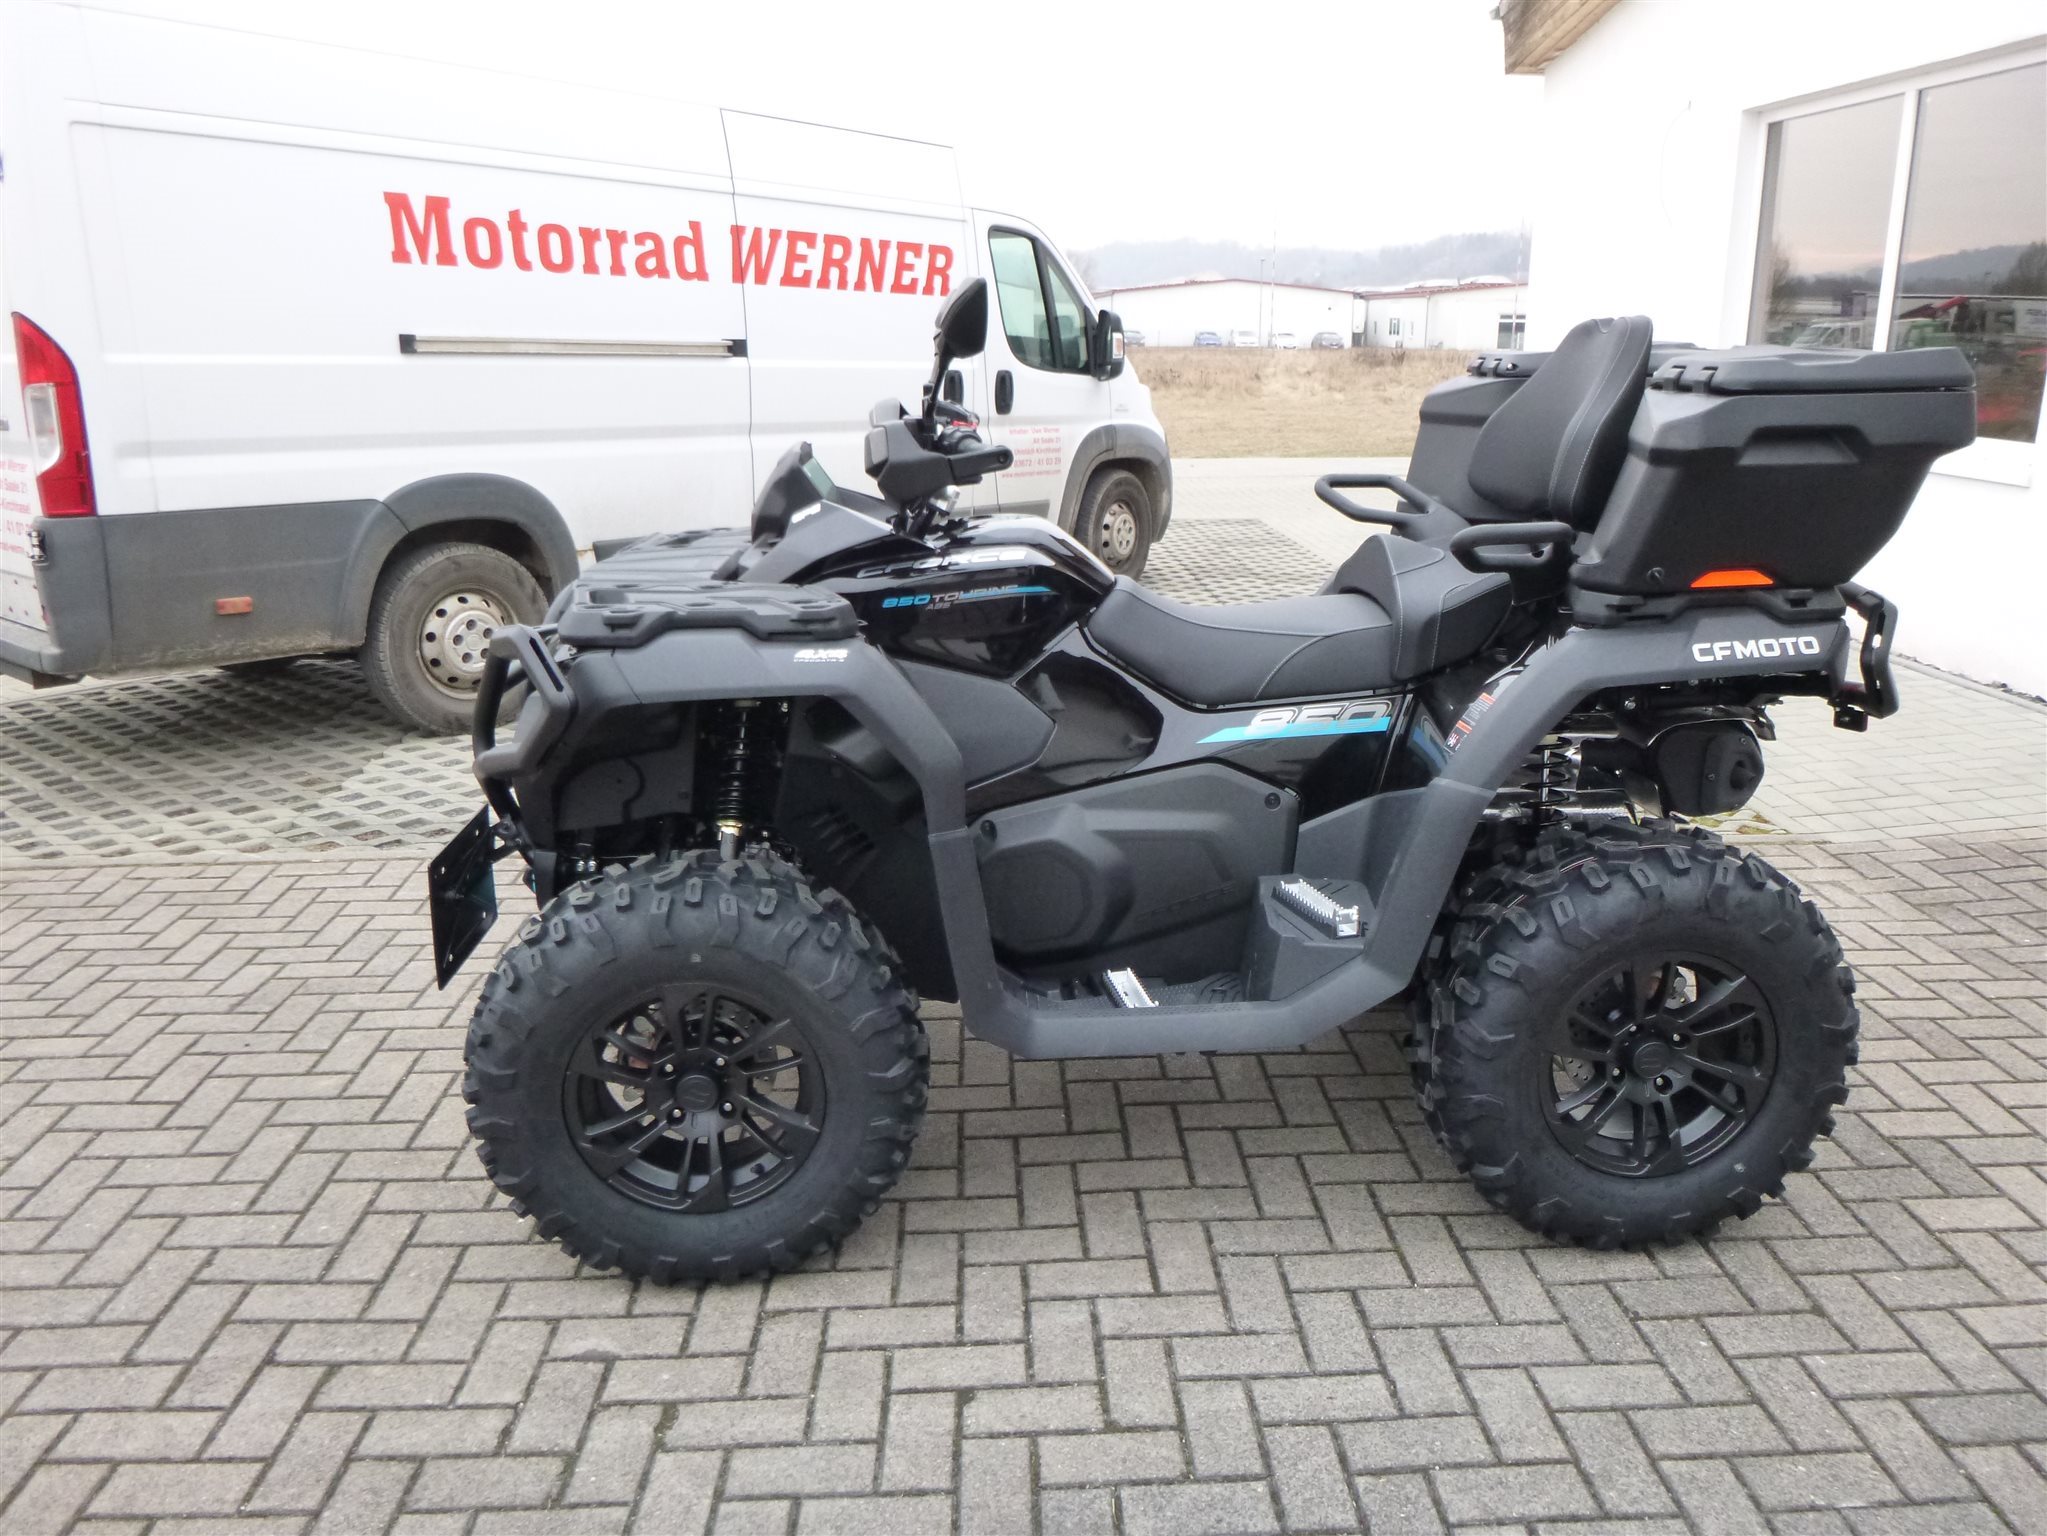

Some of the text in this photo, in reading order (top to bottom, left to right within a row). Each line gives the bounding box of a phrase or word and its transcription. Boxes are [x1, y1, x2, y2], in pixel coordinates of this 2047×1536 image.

[383, 191, 954, 296] Motorrad WERNER
[882, 594, 930, 609] 850
[1691, 636, 1821, 663] CFMOTO
